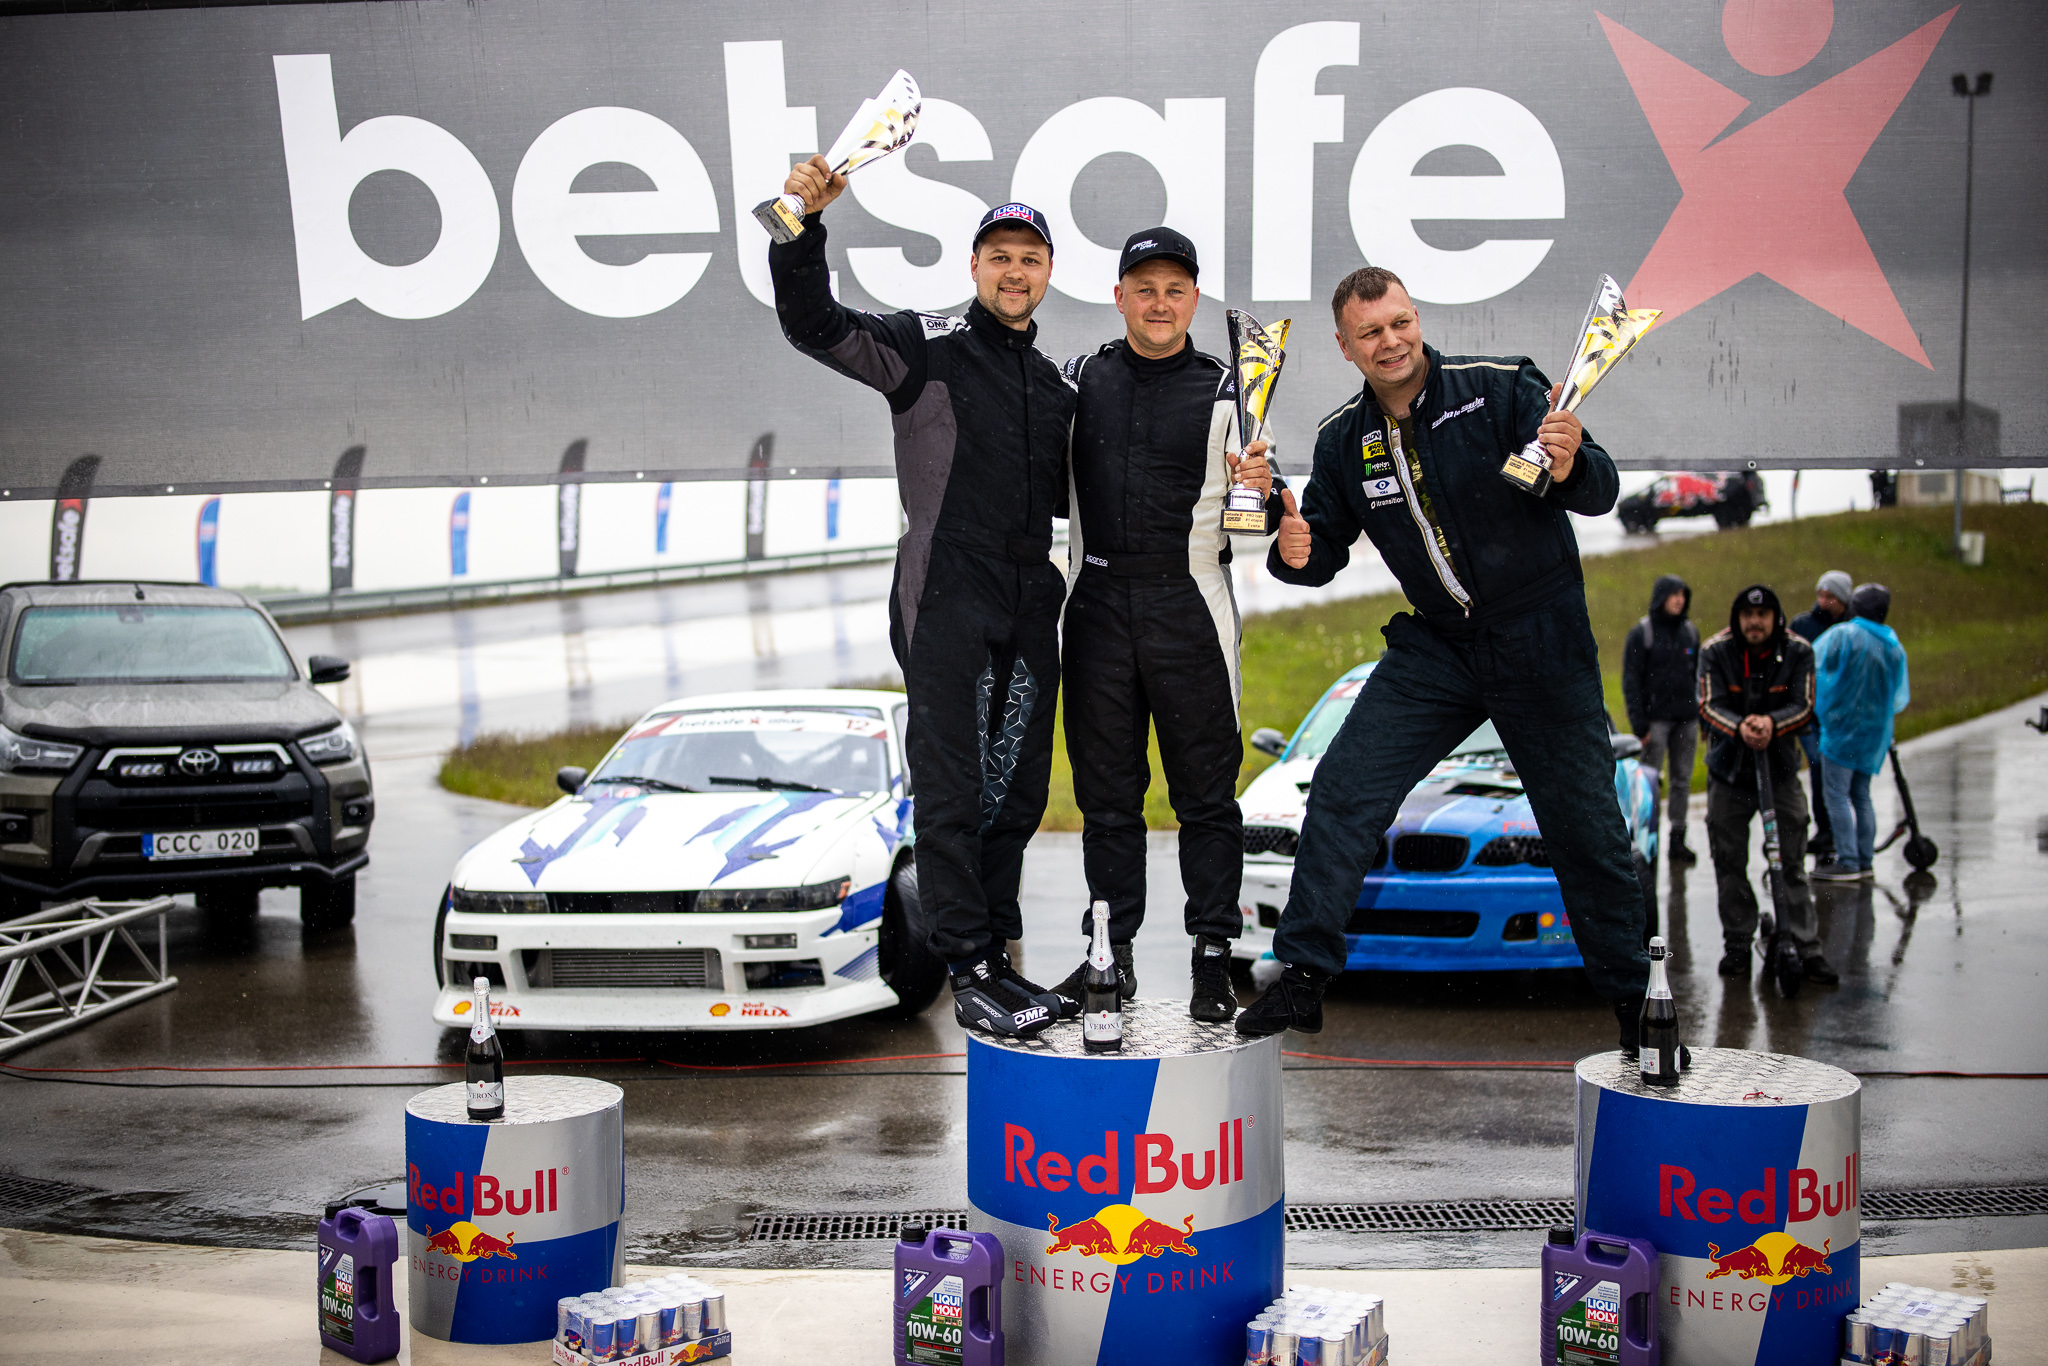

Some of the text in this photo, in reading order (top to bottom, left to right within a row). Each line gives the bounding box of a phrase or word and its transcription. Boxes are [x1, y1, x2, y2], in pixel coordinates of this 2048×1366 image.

[273, 20, 1566, 321] betsafe
[926, 320, 948, 330] OMP
[156, 831, 255, 854] CCC 020
[489, 1005, 521, 1017] ELIX
[741, 1008, 791, 1017] HELIX
[1014, 1007, 1049, 1026] OMP
[1004, 1117, 1244, 1196] Red Bull
[408, 1161, 558, 1217] Red Bull
[1659, 1152, 1857, 1225] Red Bull
[336, 1269, 353, 1285] LIQUI
[413, 1255, 548, 1284] ENERGY DRINK
[1015, 1259, 1235, 1295] ENERGY DRINK
[336, 1279, 353, 1295] MOLY
[1669, 1276, 1853, 1313] ENERGY DRINK
[321, 1294, 353, 1320] 10W-60
[934, 1293, 961, 1307] LIQUI
[1587, 1298, 1617, 1313] LIQUI
[934, 1304, 961, 1317] MOLY
[1587, 1309, 1617, 1323] MOLY
[906, 1320, 962, 1345] 10W-60
[1557, 1324, 1619, 1351] 10W-60
[595, 1345, 609, 1353] Red
[642, 1350, 664, 1366] Bull
